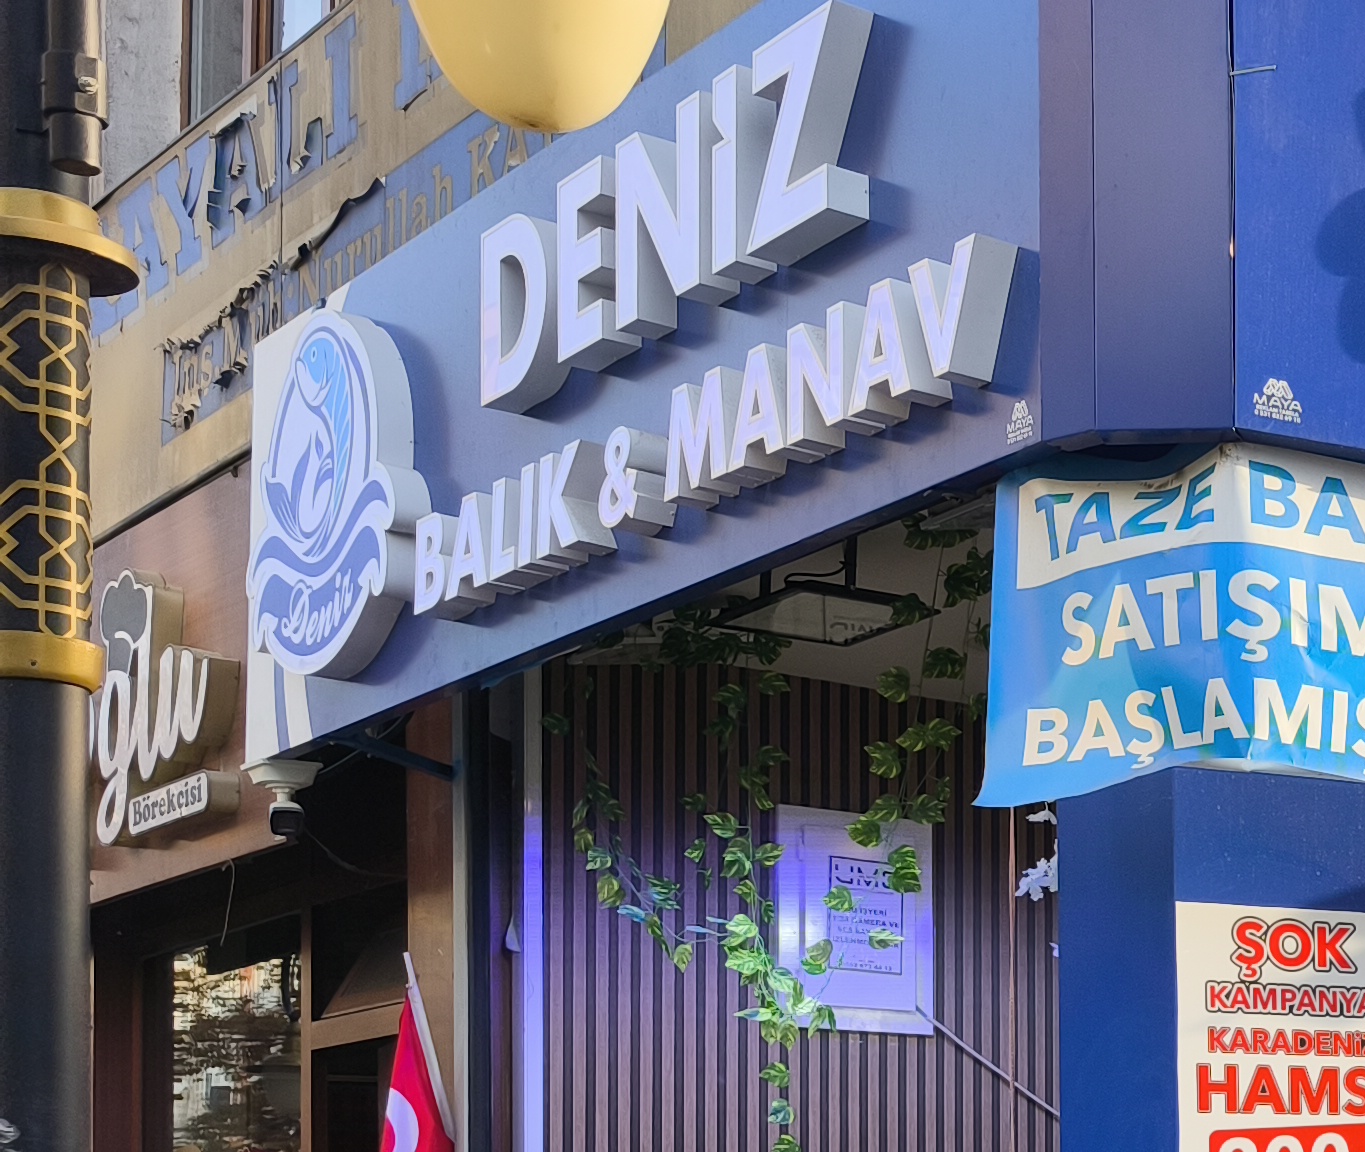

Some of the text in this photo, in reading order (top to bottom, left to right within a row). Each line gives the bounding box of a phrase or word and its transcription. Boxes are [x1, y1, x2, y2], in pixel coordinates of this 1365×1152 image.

[95, 12, 358, 342] AYALI
[414, 440, 592, 616] BALIK
[664, 233, 1000, 506] MANAV
[1006, 414, 1034, 434] MAYA
[1253, 392, 1303, 414] MAYA
[1034, 460, 1218, 562] TAZE
[132, 775, 204, 828] Börekçisi
[1229, 916, 1358, 981] ŞOK
